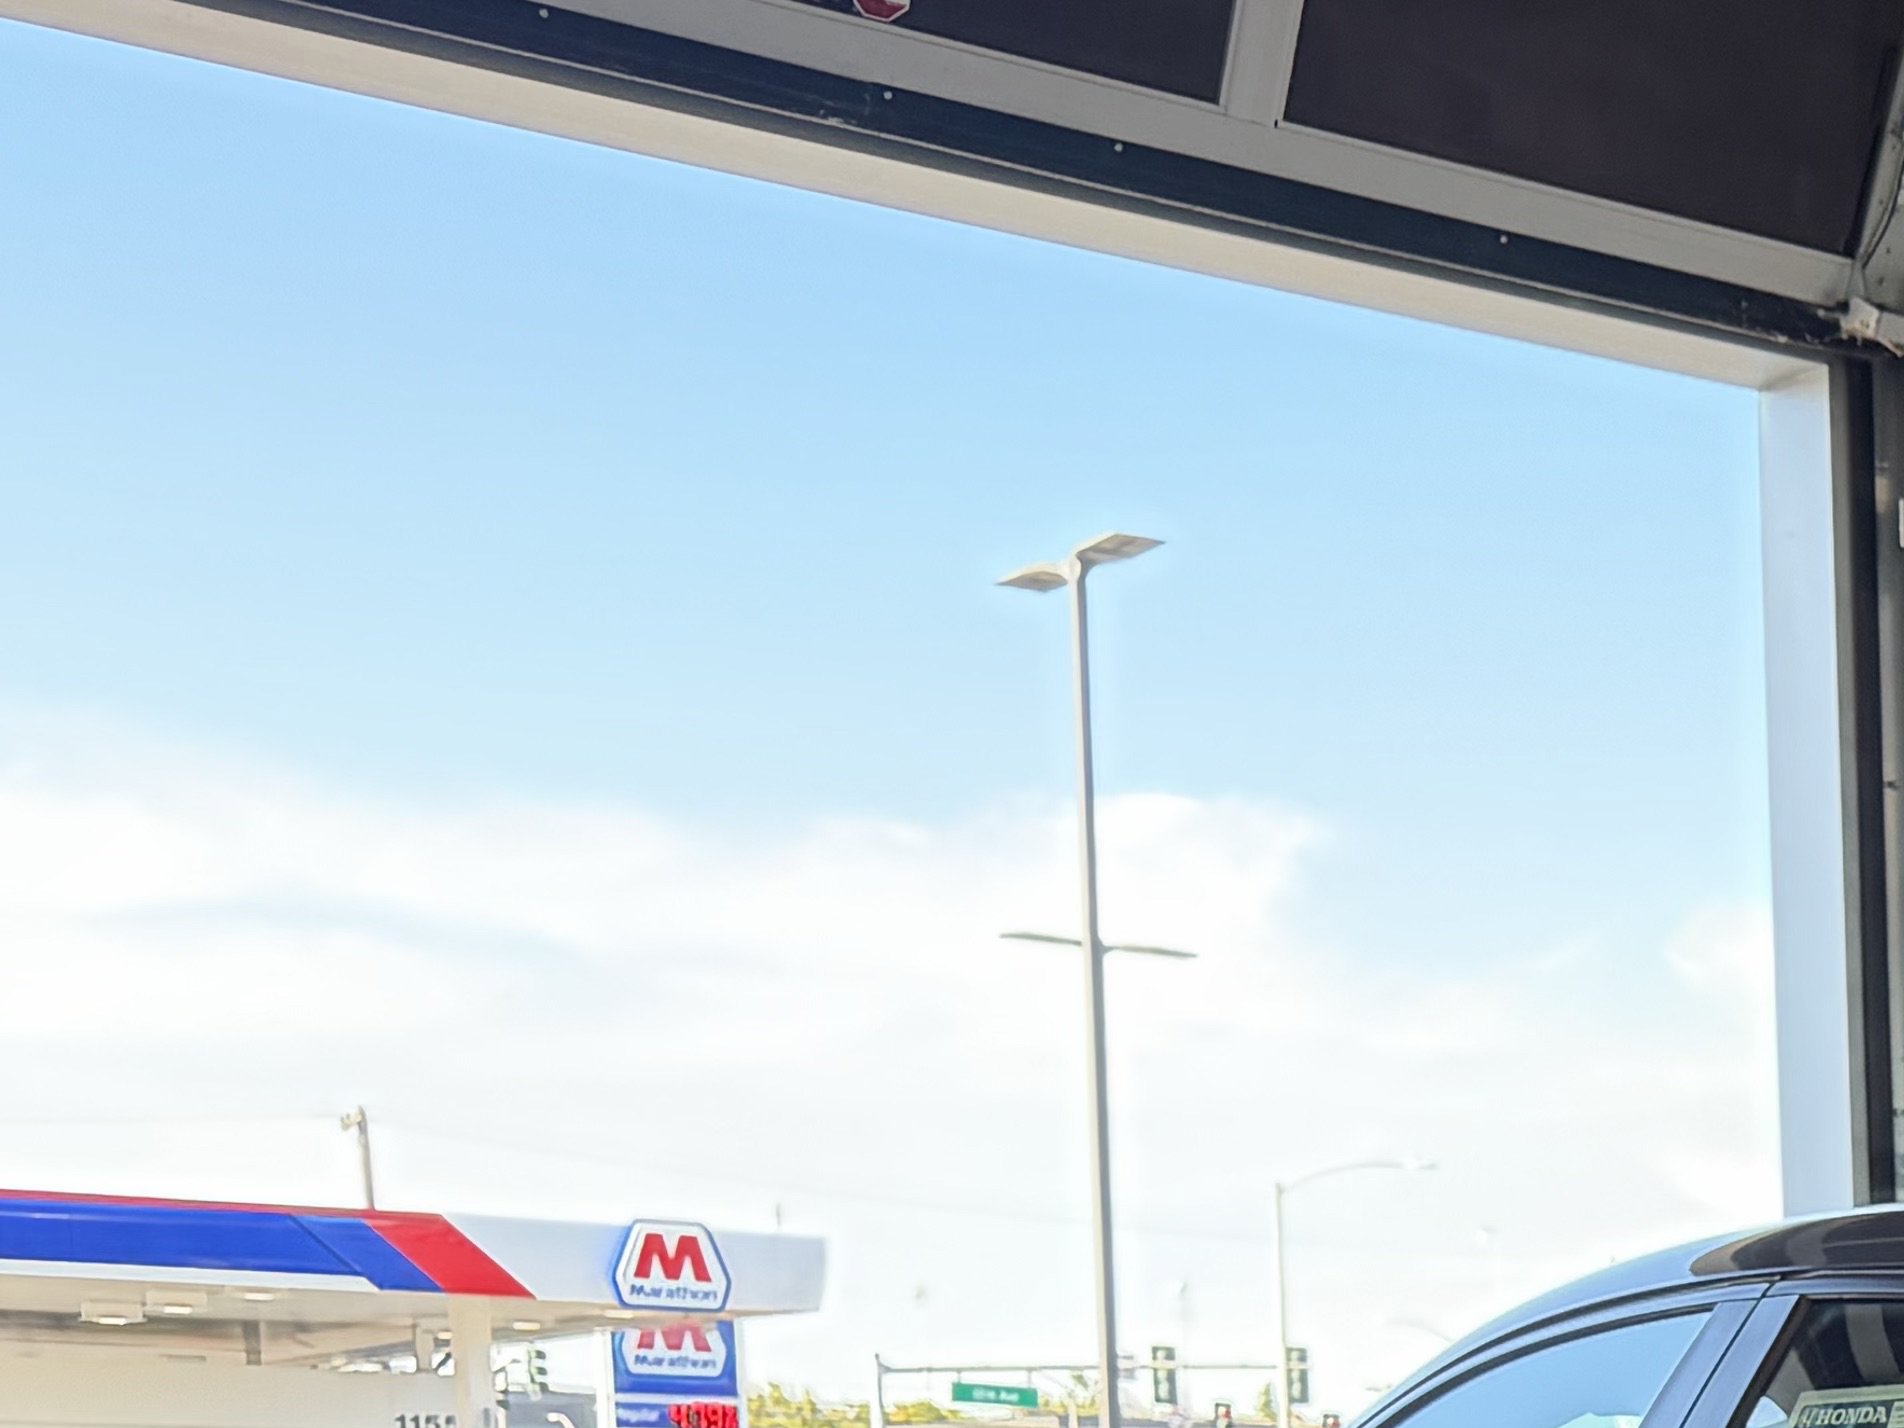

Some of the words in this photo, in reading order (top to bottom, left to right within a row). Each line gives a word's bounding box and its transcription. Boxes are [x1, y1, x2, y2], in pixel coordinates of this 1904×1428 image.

[629, 1284, 717, 1301] Marathon
[634, 1354, 716, 1369] Marathon
[1815, 1406, 1887, 1426] HONDA
